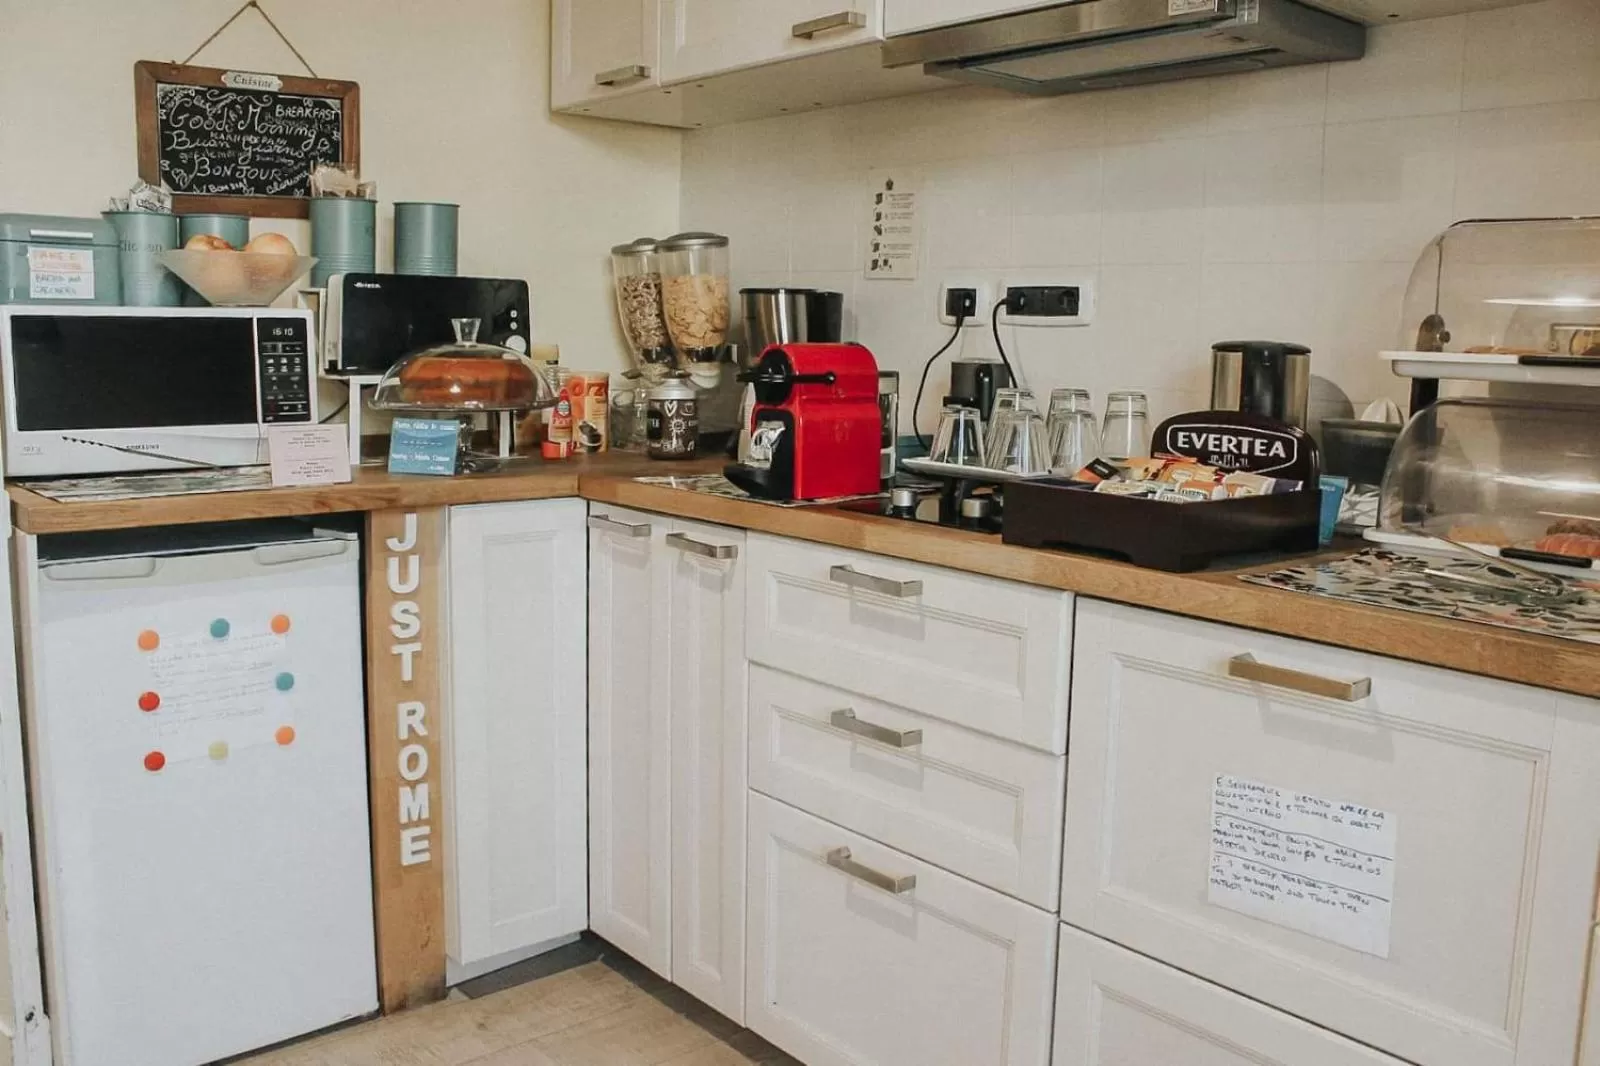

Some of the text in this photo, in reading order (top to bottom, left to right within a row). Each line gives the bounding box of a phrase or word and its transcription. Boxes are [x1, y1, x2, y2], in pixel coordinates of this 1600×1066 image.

[170, 98, 227, 130] Good
[238, 104, 316, 151] Morning
[275, 104, 336, 120] BREAKFAST
[1177, 431, 1287, 458] EVERTEA
[385, 512, 432, 867] JUST ROME
